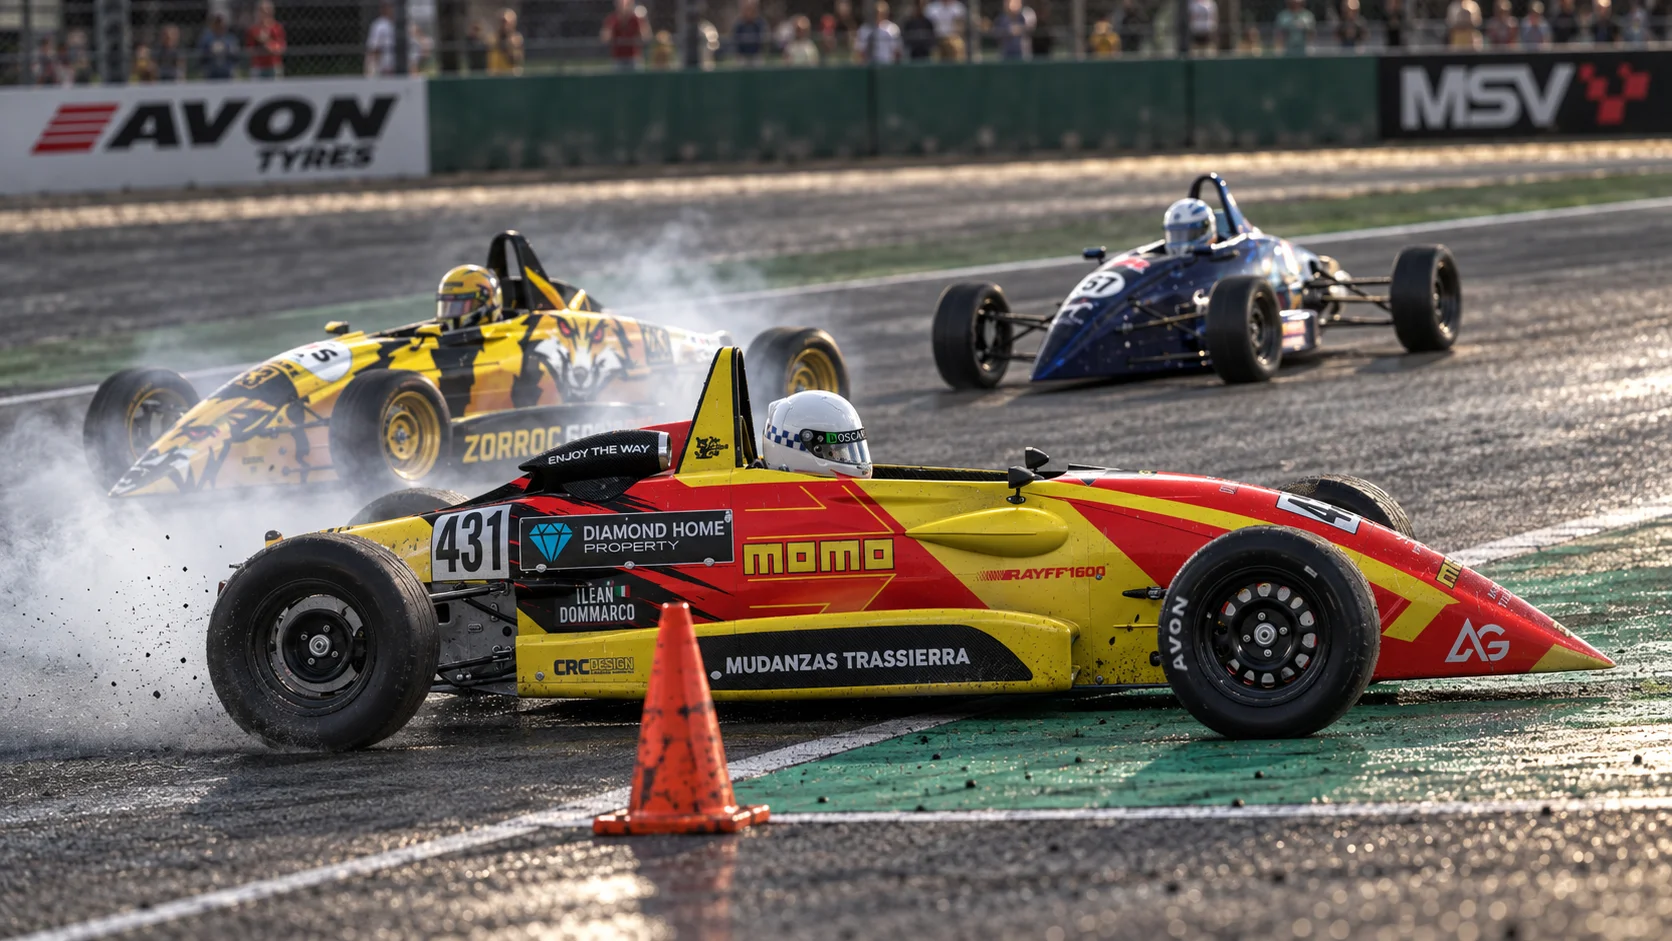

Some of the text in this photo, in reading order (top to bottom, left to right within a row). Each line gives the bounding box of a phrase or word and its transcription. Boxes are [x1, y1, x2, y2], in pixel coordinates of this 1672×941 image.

[1402, 63, 1575, 130] MSV
[107, 96, 398, 150] AVON
[257, 145, 374, 172] TYRES
[462, 425, 561, 464] ZORROC
[548, 444, 650, 465] ENJOY THE WAY
[435, 510, 504, 573] 431
[584, 521, 725, 541] DIAMOND HOME
[584, 540, 679, 553] PROPERTY
[560, 604, 635, 623] DOMMARCO
[1169, 596, 1189, 671] AVON
[1444, 617, 1510, 662] AG
[726, 647, 970, 674] MUDANZAS TRASSIERRA
